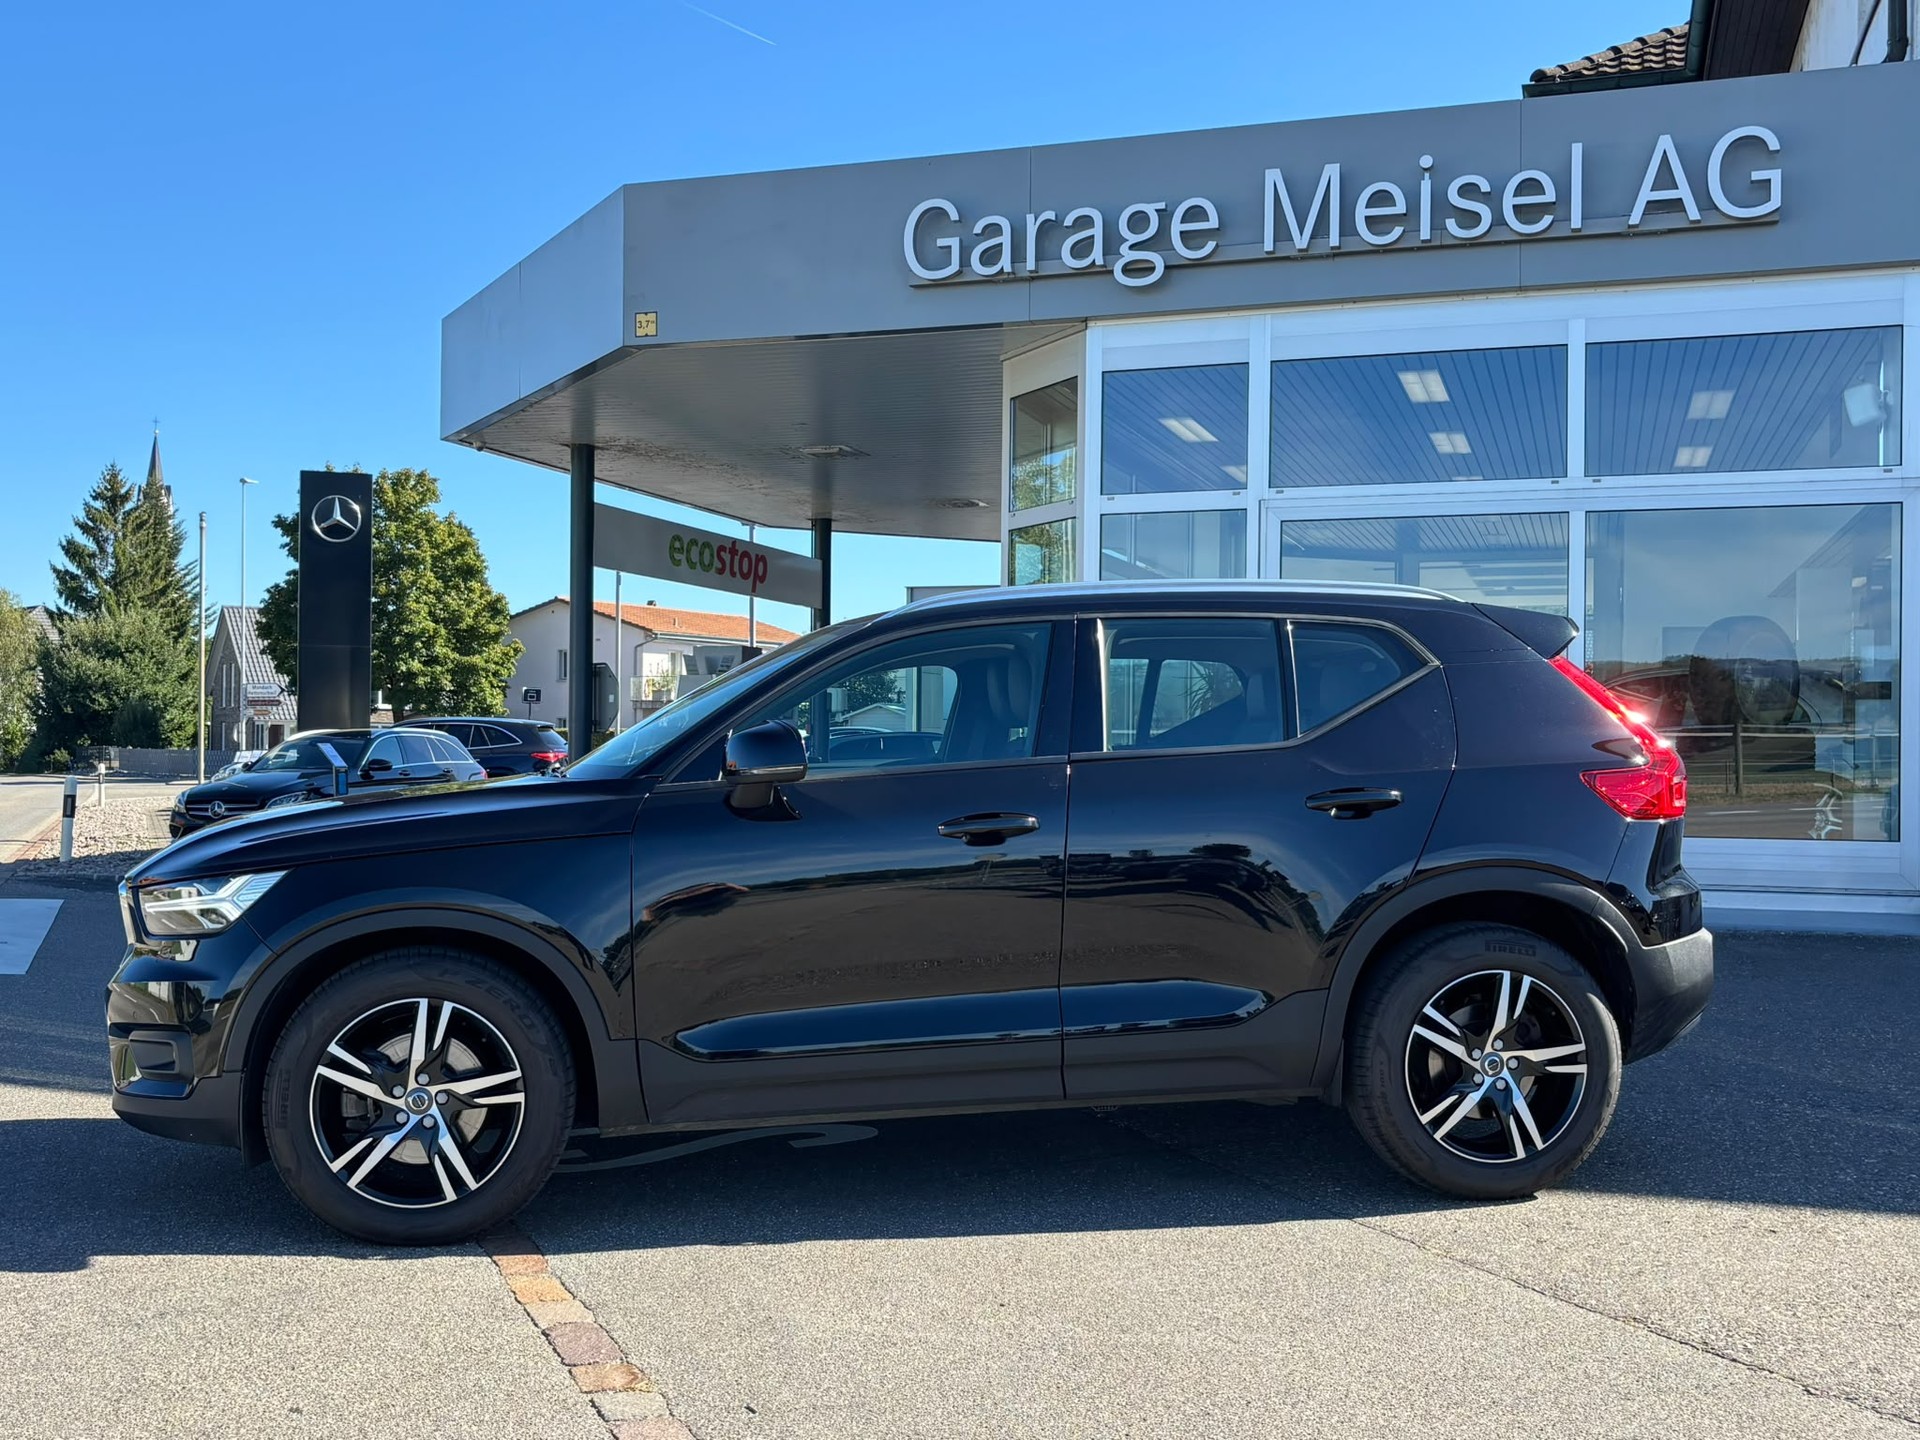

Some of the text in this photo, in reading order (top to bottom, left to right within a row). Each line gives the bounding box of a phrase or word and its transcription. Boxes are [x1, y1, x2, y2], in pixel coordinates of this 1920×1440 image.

[903, 126, 1783, 288] Garage Meisel AG
[668, 533, 768, 594] ecostop
